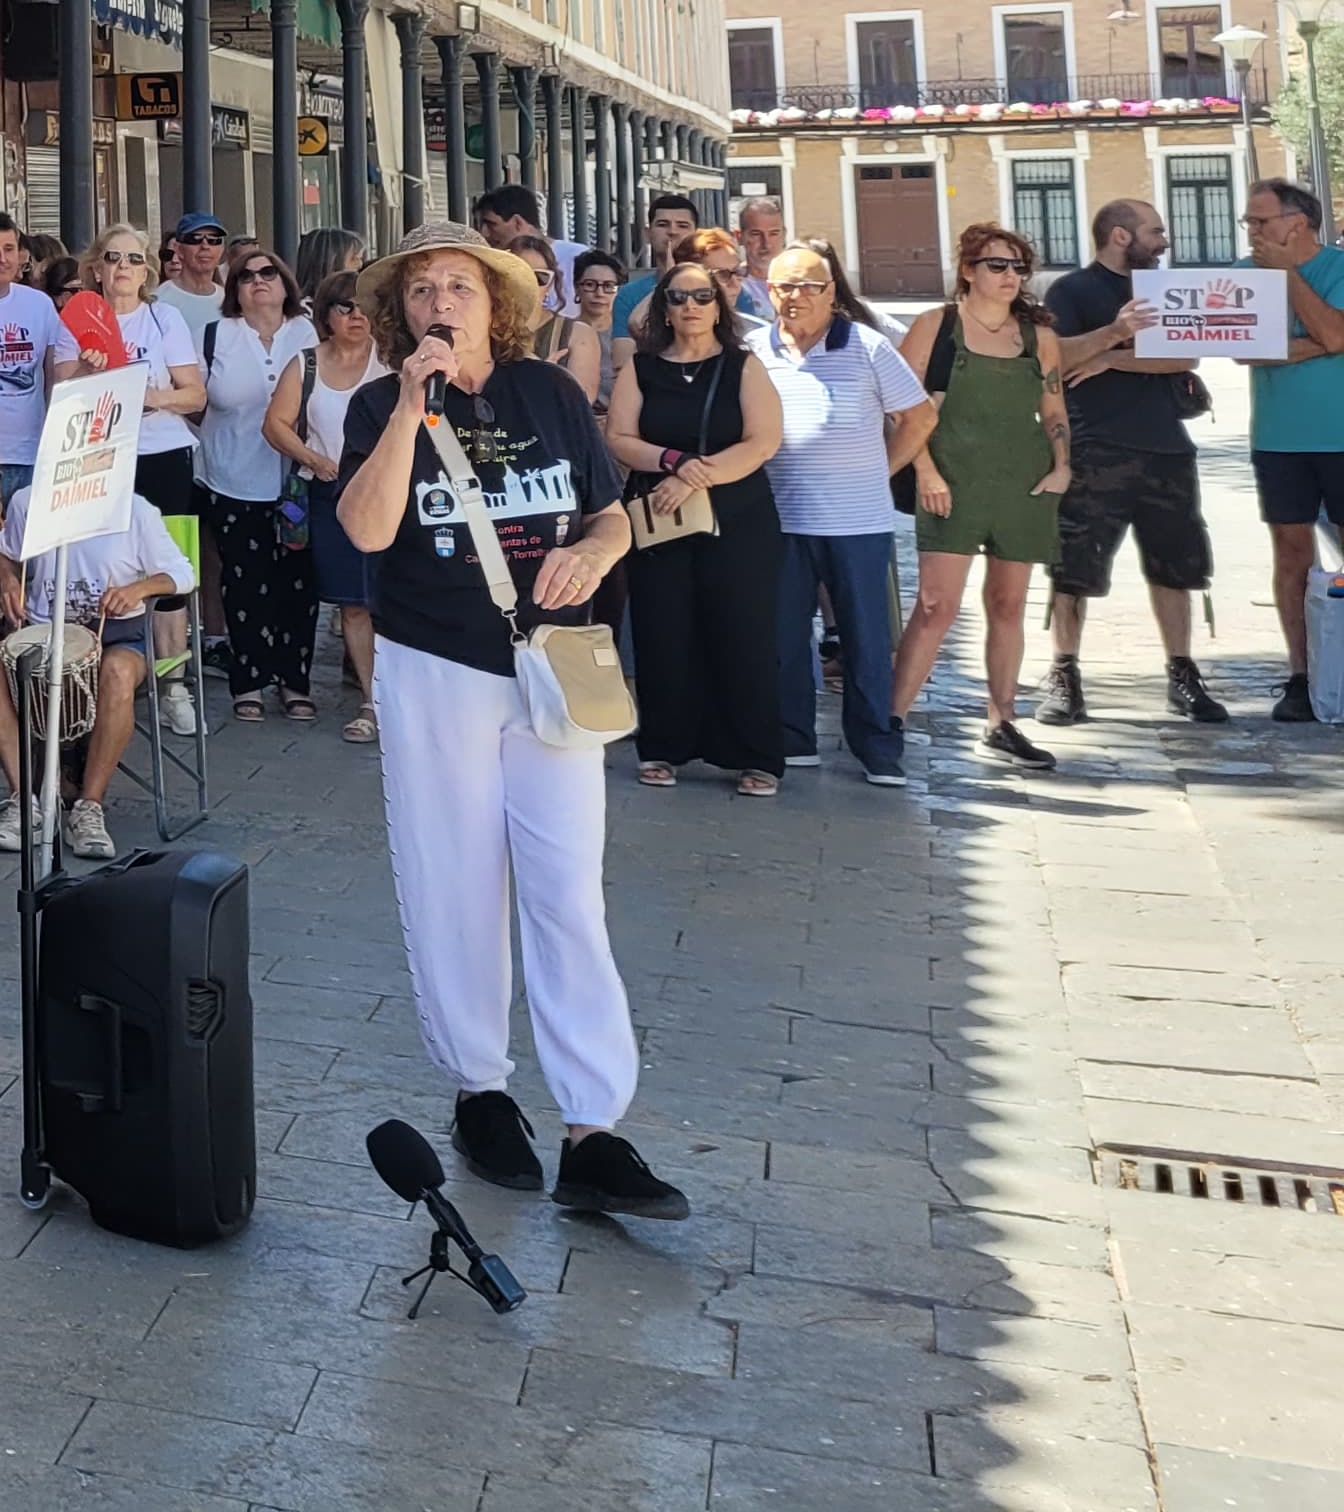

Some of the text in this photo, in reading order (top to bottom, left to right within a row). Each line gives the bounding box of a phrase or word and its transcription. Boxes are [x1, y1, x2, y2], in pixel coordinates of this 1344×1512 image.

[134, 105, 176, 116] TABACOS
[1166, 329, 1256, 341] DAIMIEL
[50, 476, 108, 513] DAIMIEL
